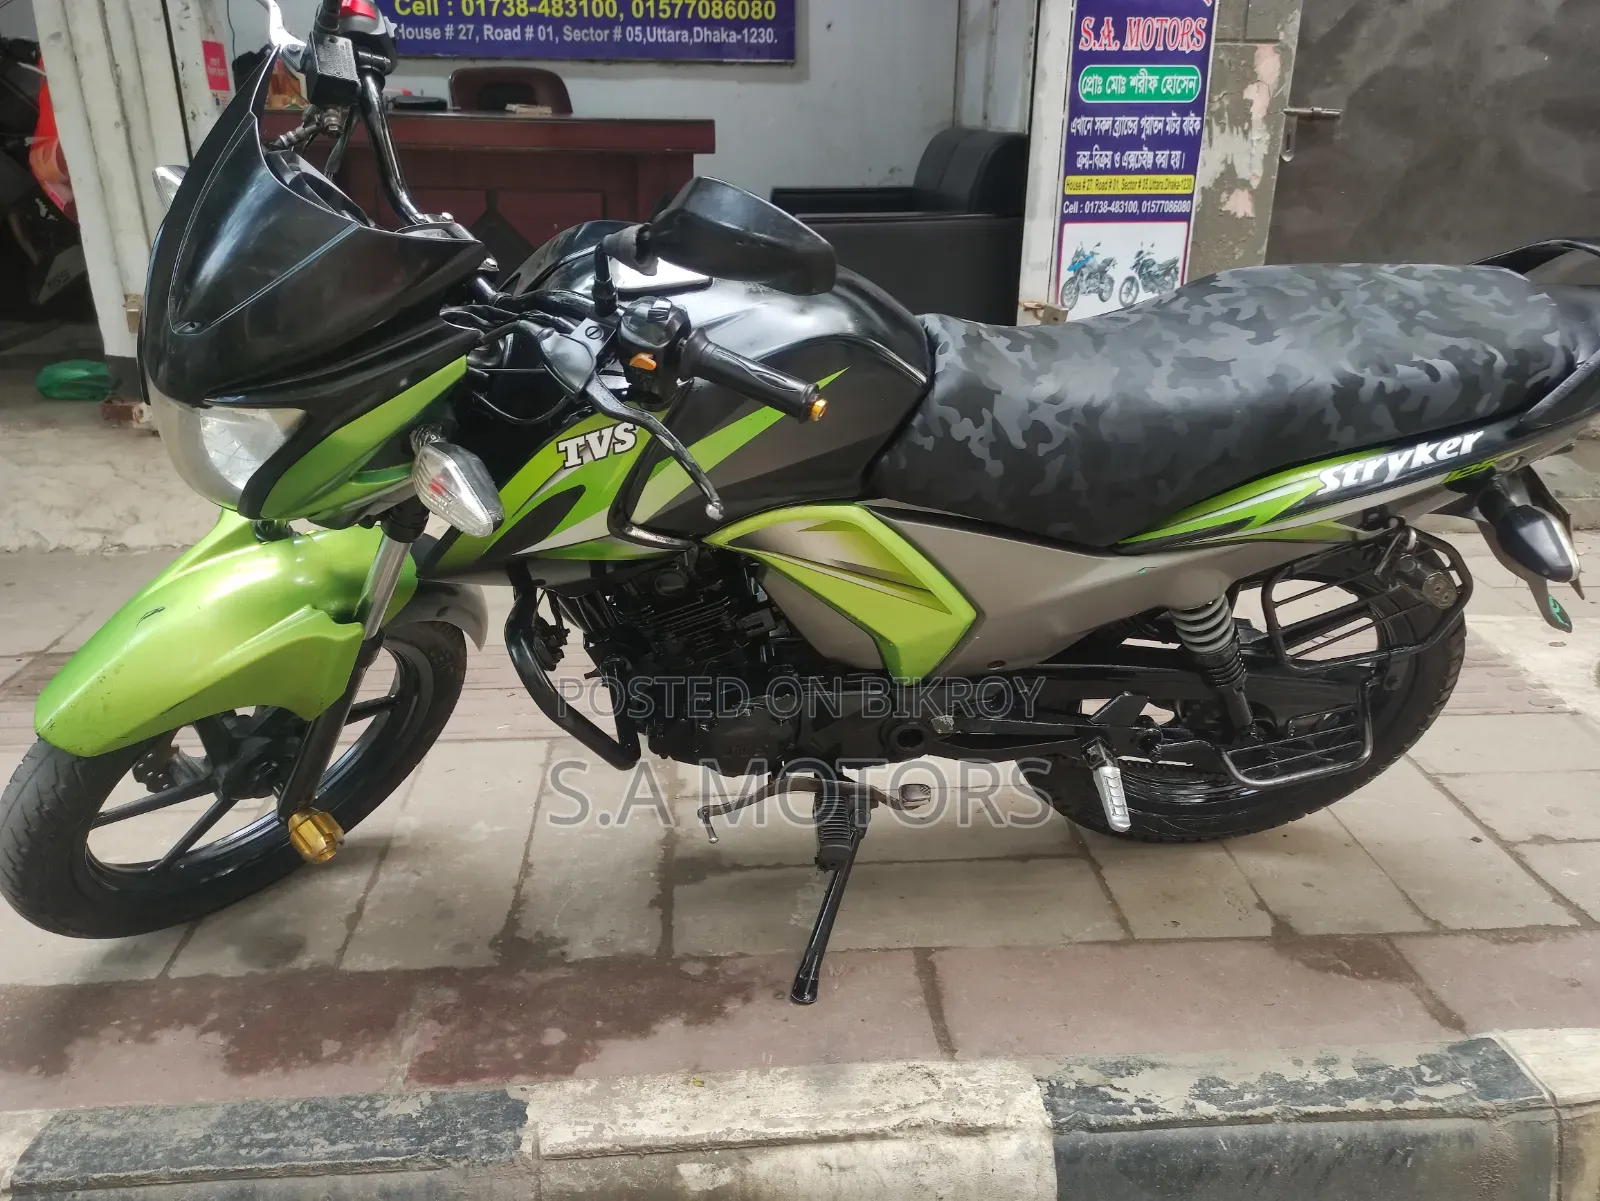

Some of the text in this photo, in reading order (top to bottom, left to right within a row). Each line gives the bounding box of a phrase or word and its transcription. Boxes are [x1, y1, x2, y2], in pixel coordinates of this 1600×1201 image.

[395, 0, 439, 16] Cell
[461, 0, 624, 22] 01738-483100,
[631, 0, 776, 20] 01577086080
[445, 24, 455, 40] #
[457, 24, 480, 43] 27,
[483, 24, 522, 41] Road
[525, 25, 535, 41] #
[537, 25, 559, 44] 01,
[563, 26, 610, 42] Sector
[612, 26, 622, 42] #
[1079, 16, 1208, 54] S.A. MOTORS
[1129, 68, 1160, 95] শরীফ
[1160, 75, 1198, 95] হোসেন
[1070, 115, 1094, 137] এখানে
[1094, 116, 1113, 137] সকল
[1182, 111, 1202, 137] বাইক
[1114, 151, 1121, 169] ও
[1155, 149, 1170, 169] করা
[1066, 179, 1082, 191] House
[1095, 178, 1108, 191] Road
[1121, 178, 1138, 191] Sector
[1063, 201, 1079, 214] Cell
[1084, 200, 1140, 215] 01738-483100,
[1141, 200, 1192, 213] 01577086080
[556, 421, 638, 470] TVS
[1315, 430, 1485, 496] Stryker
